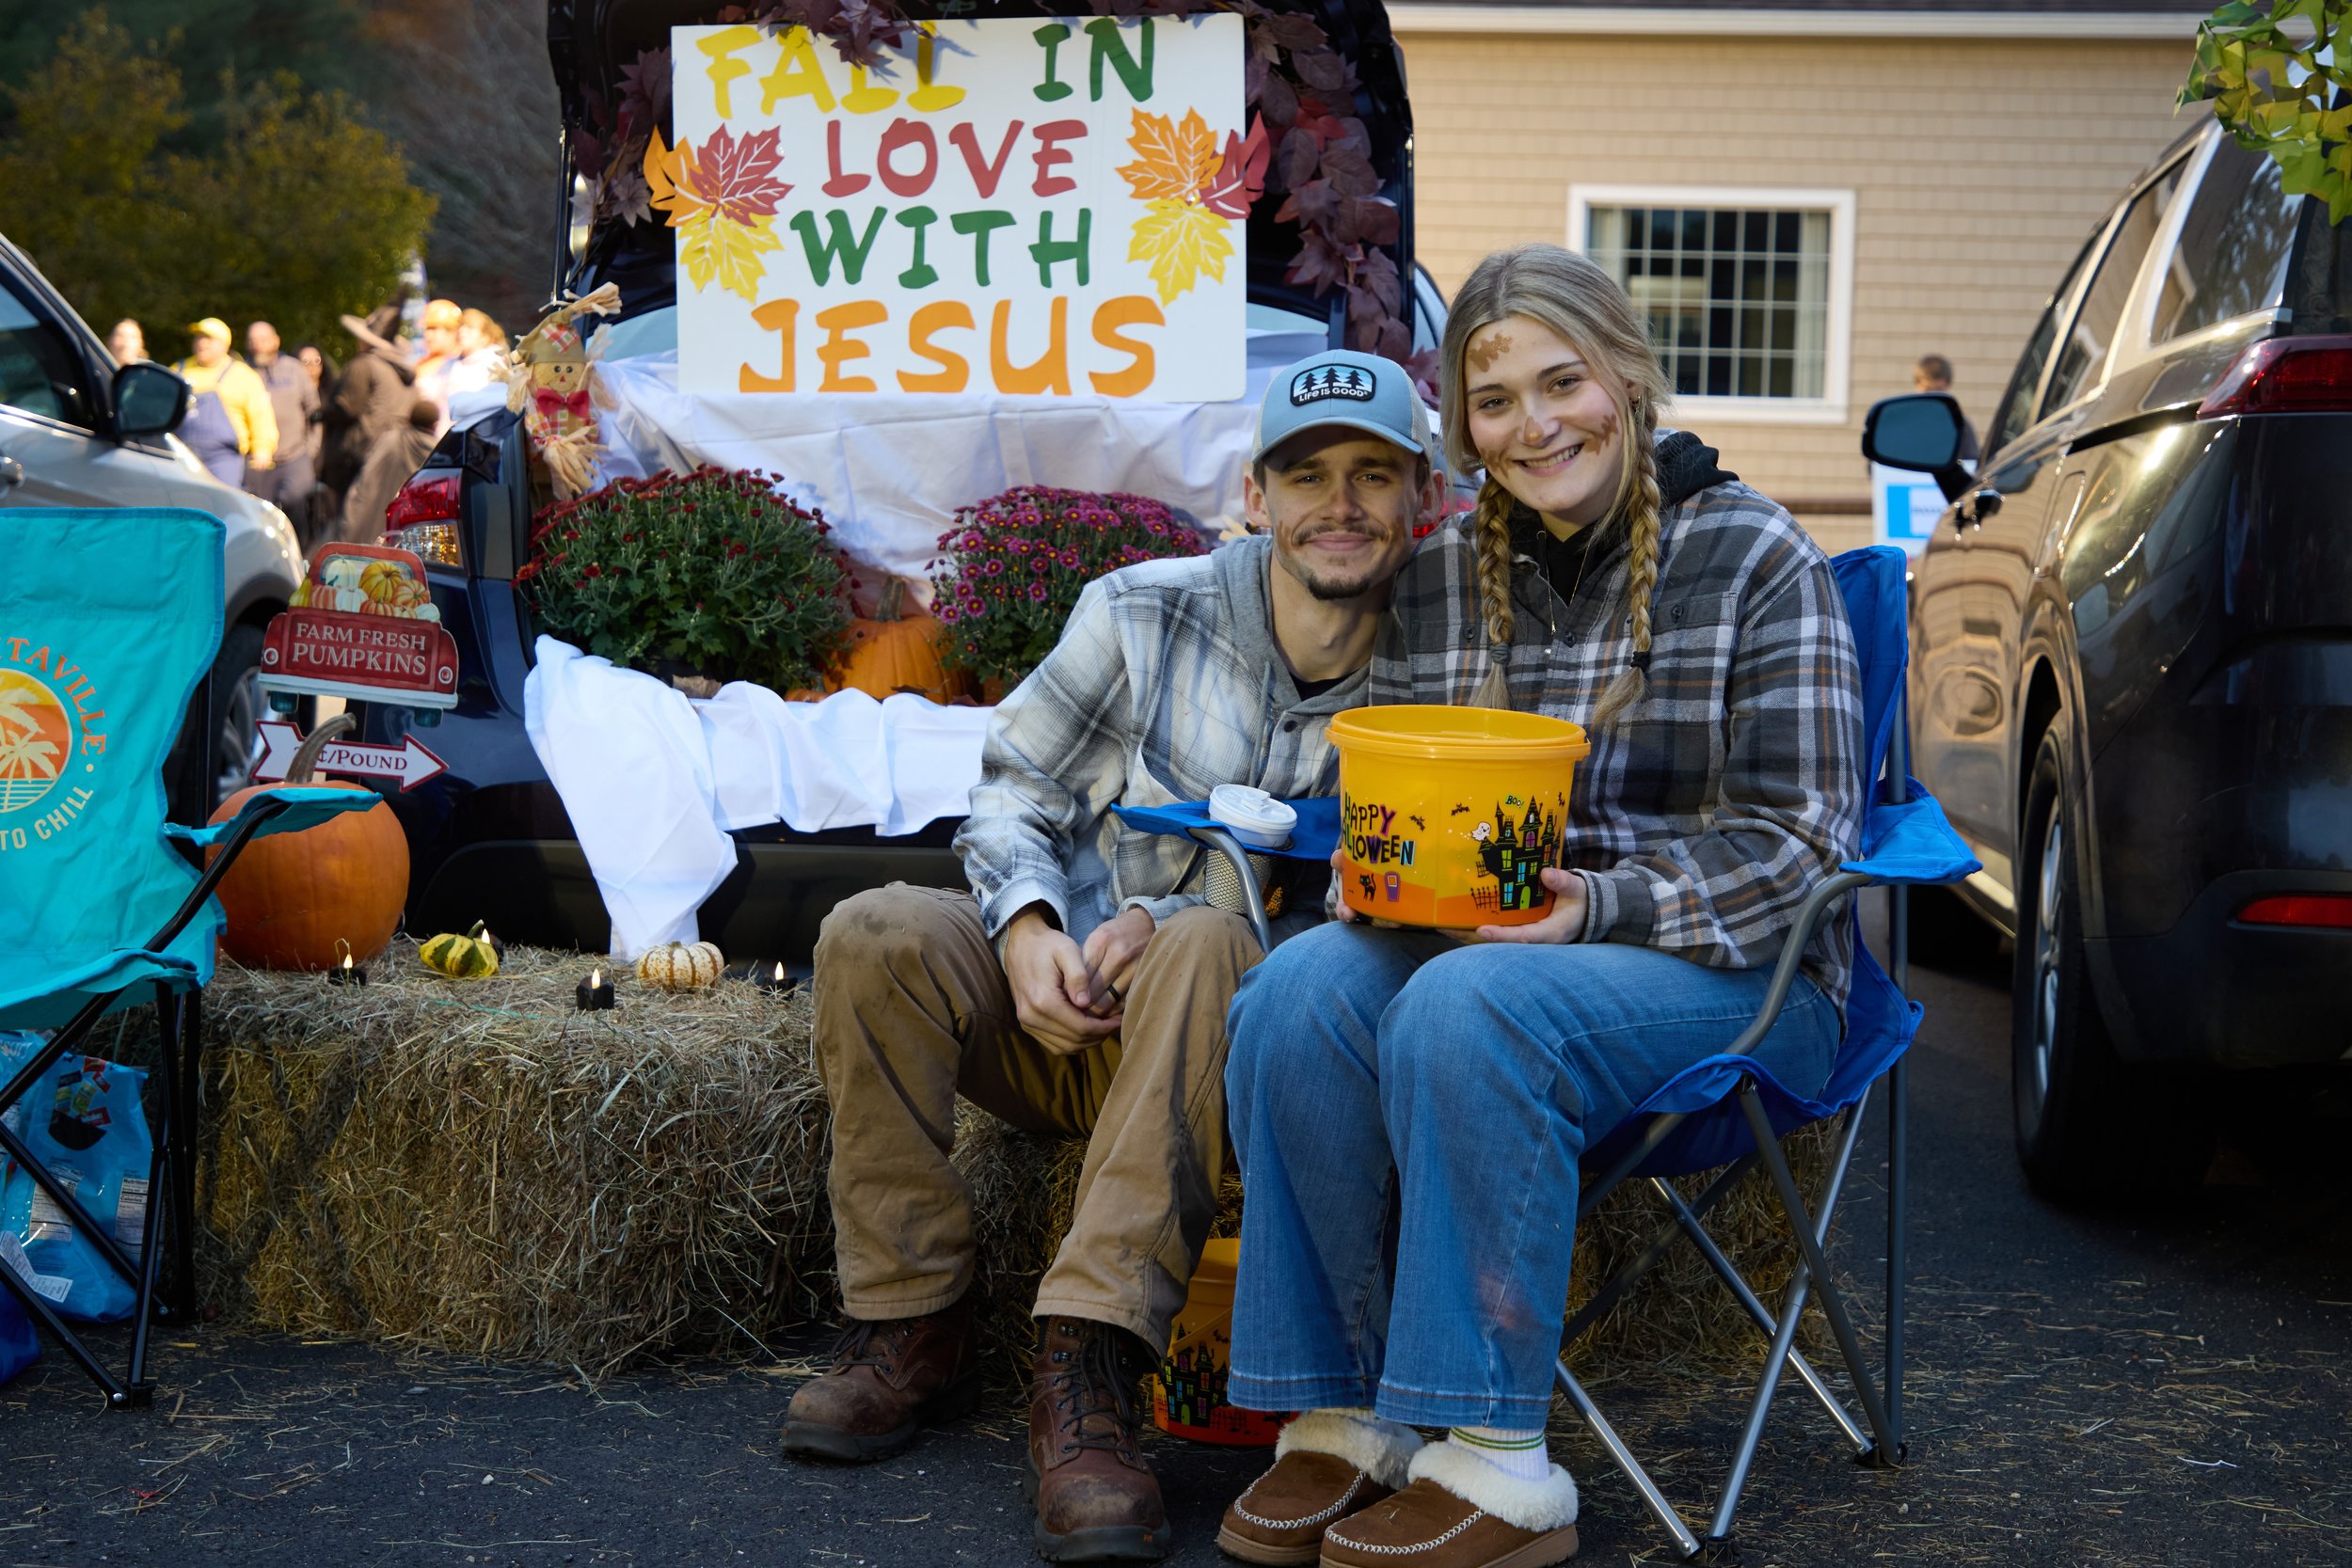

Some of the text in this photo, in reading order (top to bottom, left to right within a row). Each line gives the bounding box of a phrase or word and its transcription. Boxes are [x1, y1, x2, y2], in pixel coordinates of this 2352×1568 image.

[695, 18, 1155, 119] FALL IN
[821, 118, 1089, 198] LOVE
[789, 205, 1091, 289] WITH
[739, 295, 1166, 398] JESUS
[1321, 388, 1330, 396] IS
[292, 642, 426, 675] PUMPKINS
[296, 623, 426, 651] FARM FRESH
[0, 637, 106, 756] TAVILLE
[294, 746, 407, 771] ¢/POUND
[0, 786, 94, 851] TO CHILL
[1342, 816, 1415, 866] ALLOWEEN
[1344, 791, 1397, 837] HAPPY
